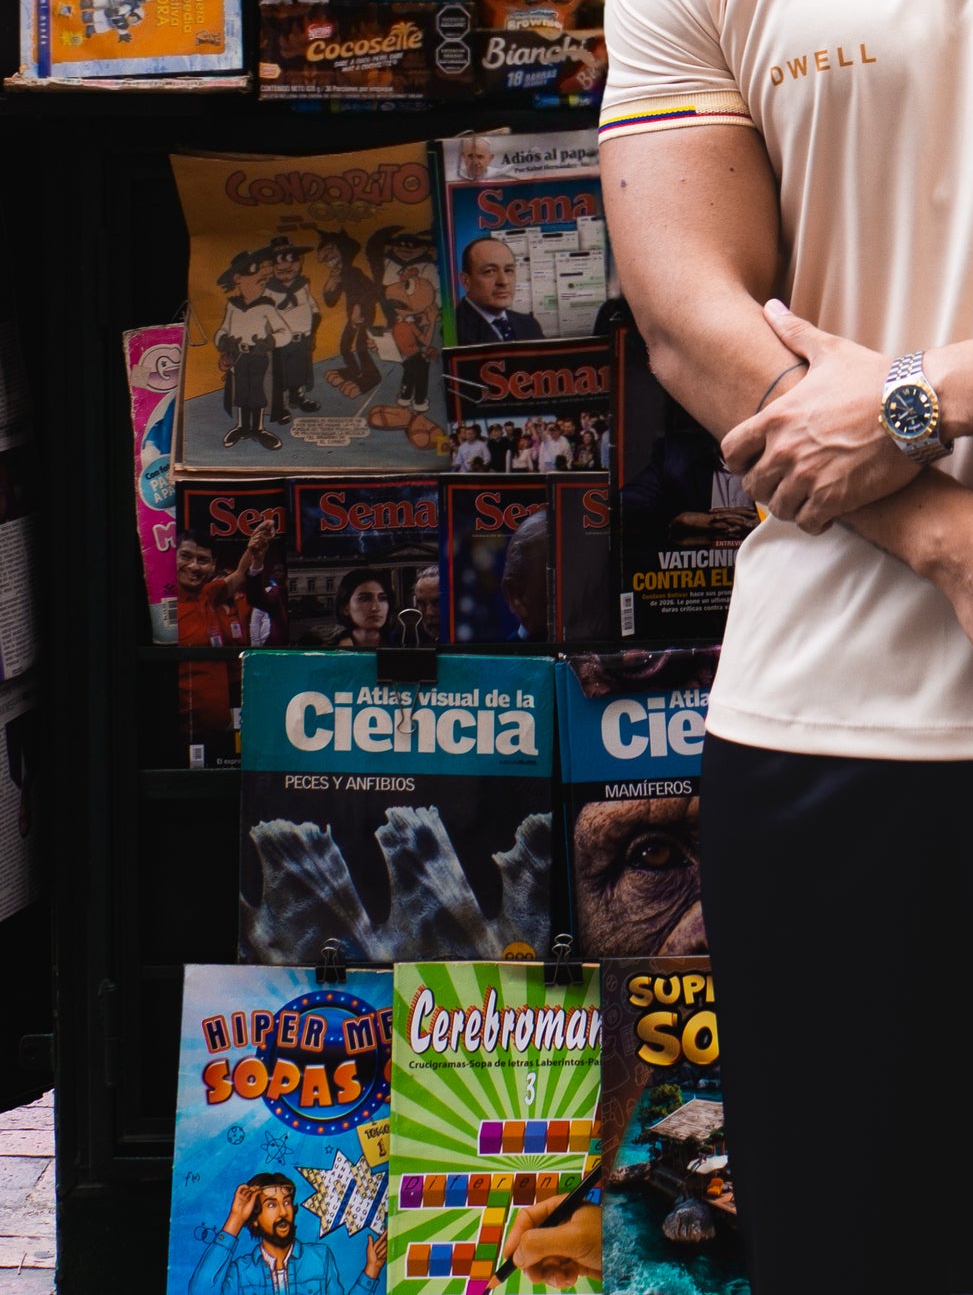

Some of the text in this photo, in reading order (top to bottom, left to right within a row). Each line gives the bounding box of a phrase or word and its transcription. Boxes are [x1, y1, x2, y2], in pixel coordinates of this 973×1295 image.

[508, 71, 523, 88] 18
[501, 148, 557, 164] Adiós al
[226, 164, 431, 206] CONDORITO
[632, 567, 734, 591] CONTRA EL
[356, 685, 535, 709] Atlas visual de la
[285, 690, 538, 755] Ciencia
[285, 775, 415, 792] PECES Y ANFIBIOS
[605, 778, 692, 798] MAMÍFEROS
[202, 1010, 327, 1053] HIPER
[636, 1010, 721, 1068] SO
[495, 1058, 534, 1069] de letras
[203, 1057, 362, 1108] SOPAS
[525, 1072, 537, 1106] 3
